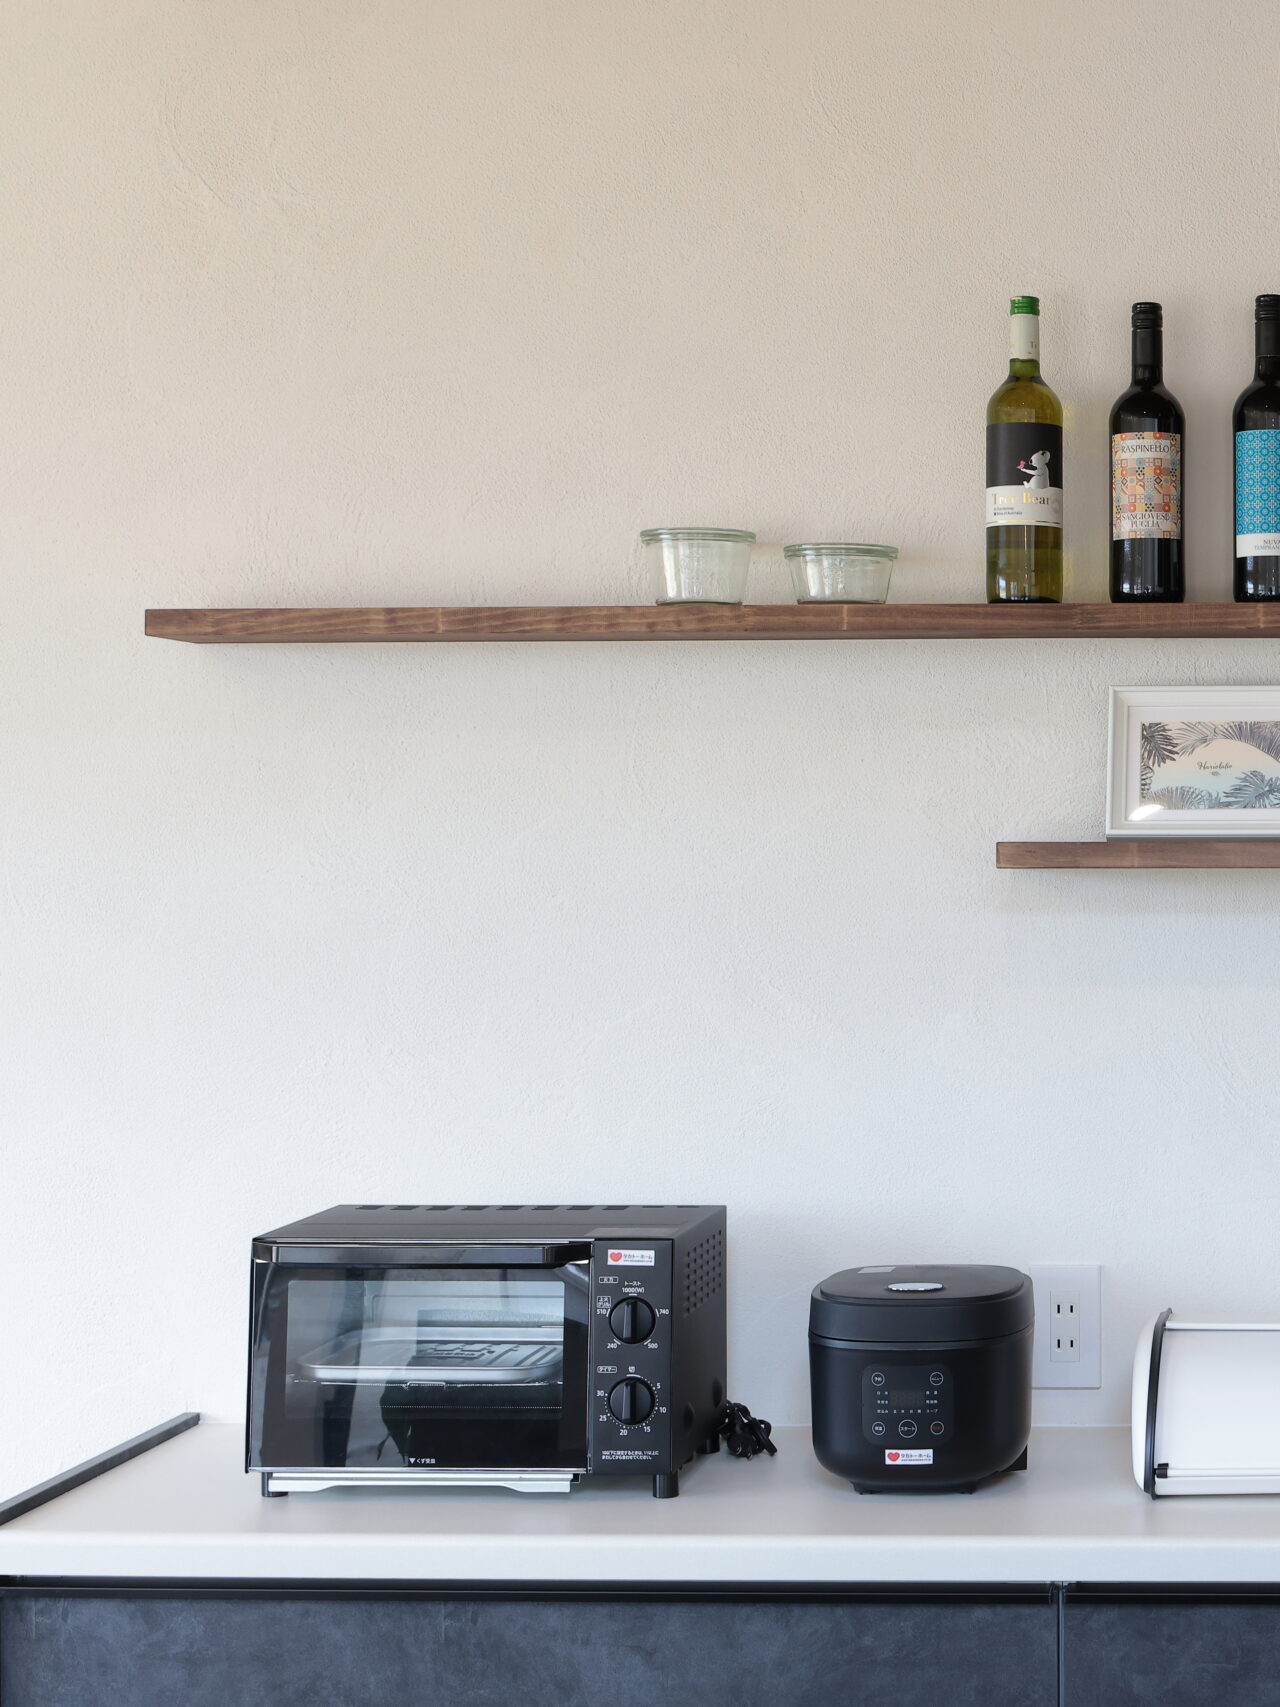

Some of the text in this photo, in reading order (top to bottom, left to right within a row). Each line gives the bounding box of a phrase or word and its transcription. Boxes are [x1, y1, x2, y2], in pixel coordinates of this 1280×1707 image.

[1121, 444, 1170, 453] RASPINELLO
[1121, 512, 1170, 521] SANGIOVESE
[1131, 520, 1160, 528] PUGLIA
